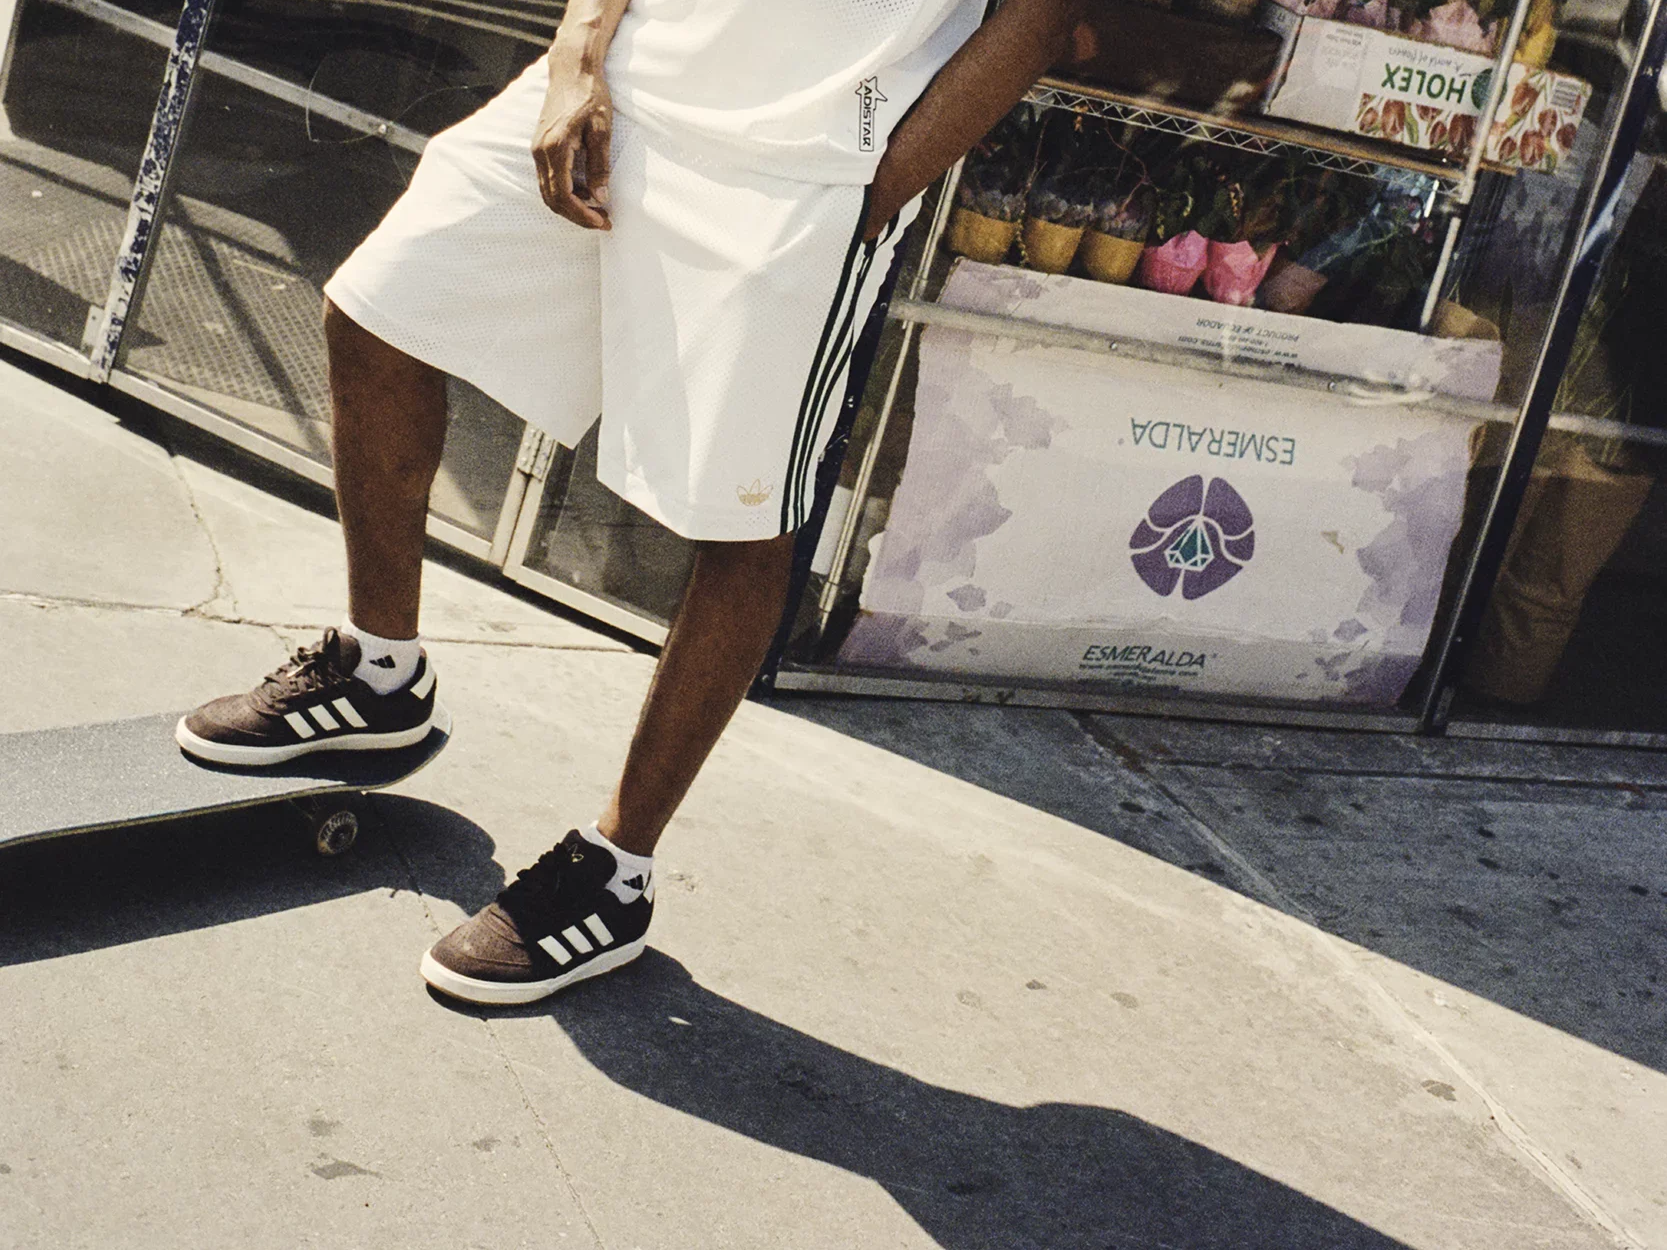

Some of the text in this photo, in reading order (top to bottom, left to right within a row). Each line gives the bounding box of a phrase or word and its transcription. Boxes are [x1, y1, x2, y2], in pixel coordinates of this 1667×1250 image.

[1381, 62, 1467, 104] HOLEX
[862, 85, 873, 146] ADISTAR
[1196, 318, 1242, 334] ECADOR
[1257, 330, 1299, 342] PRODUCT
[1131, 417, 1296, 466] ESMERALDA
[1082, 645, 1206, 668] ESMERALDA
